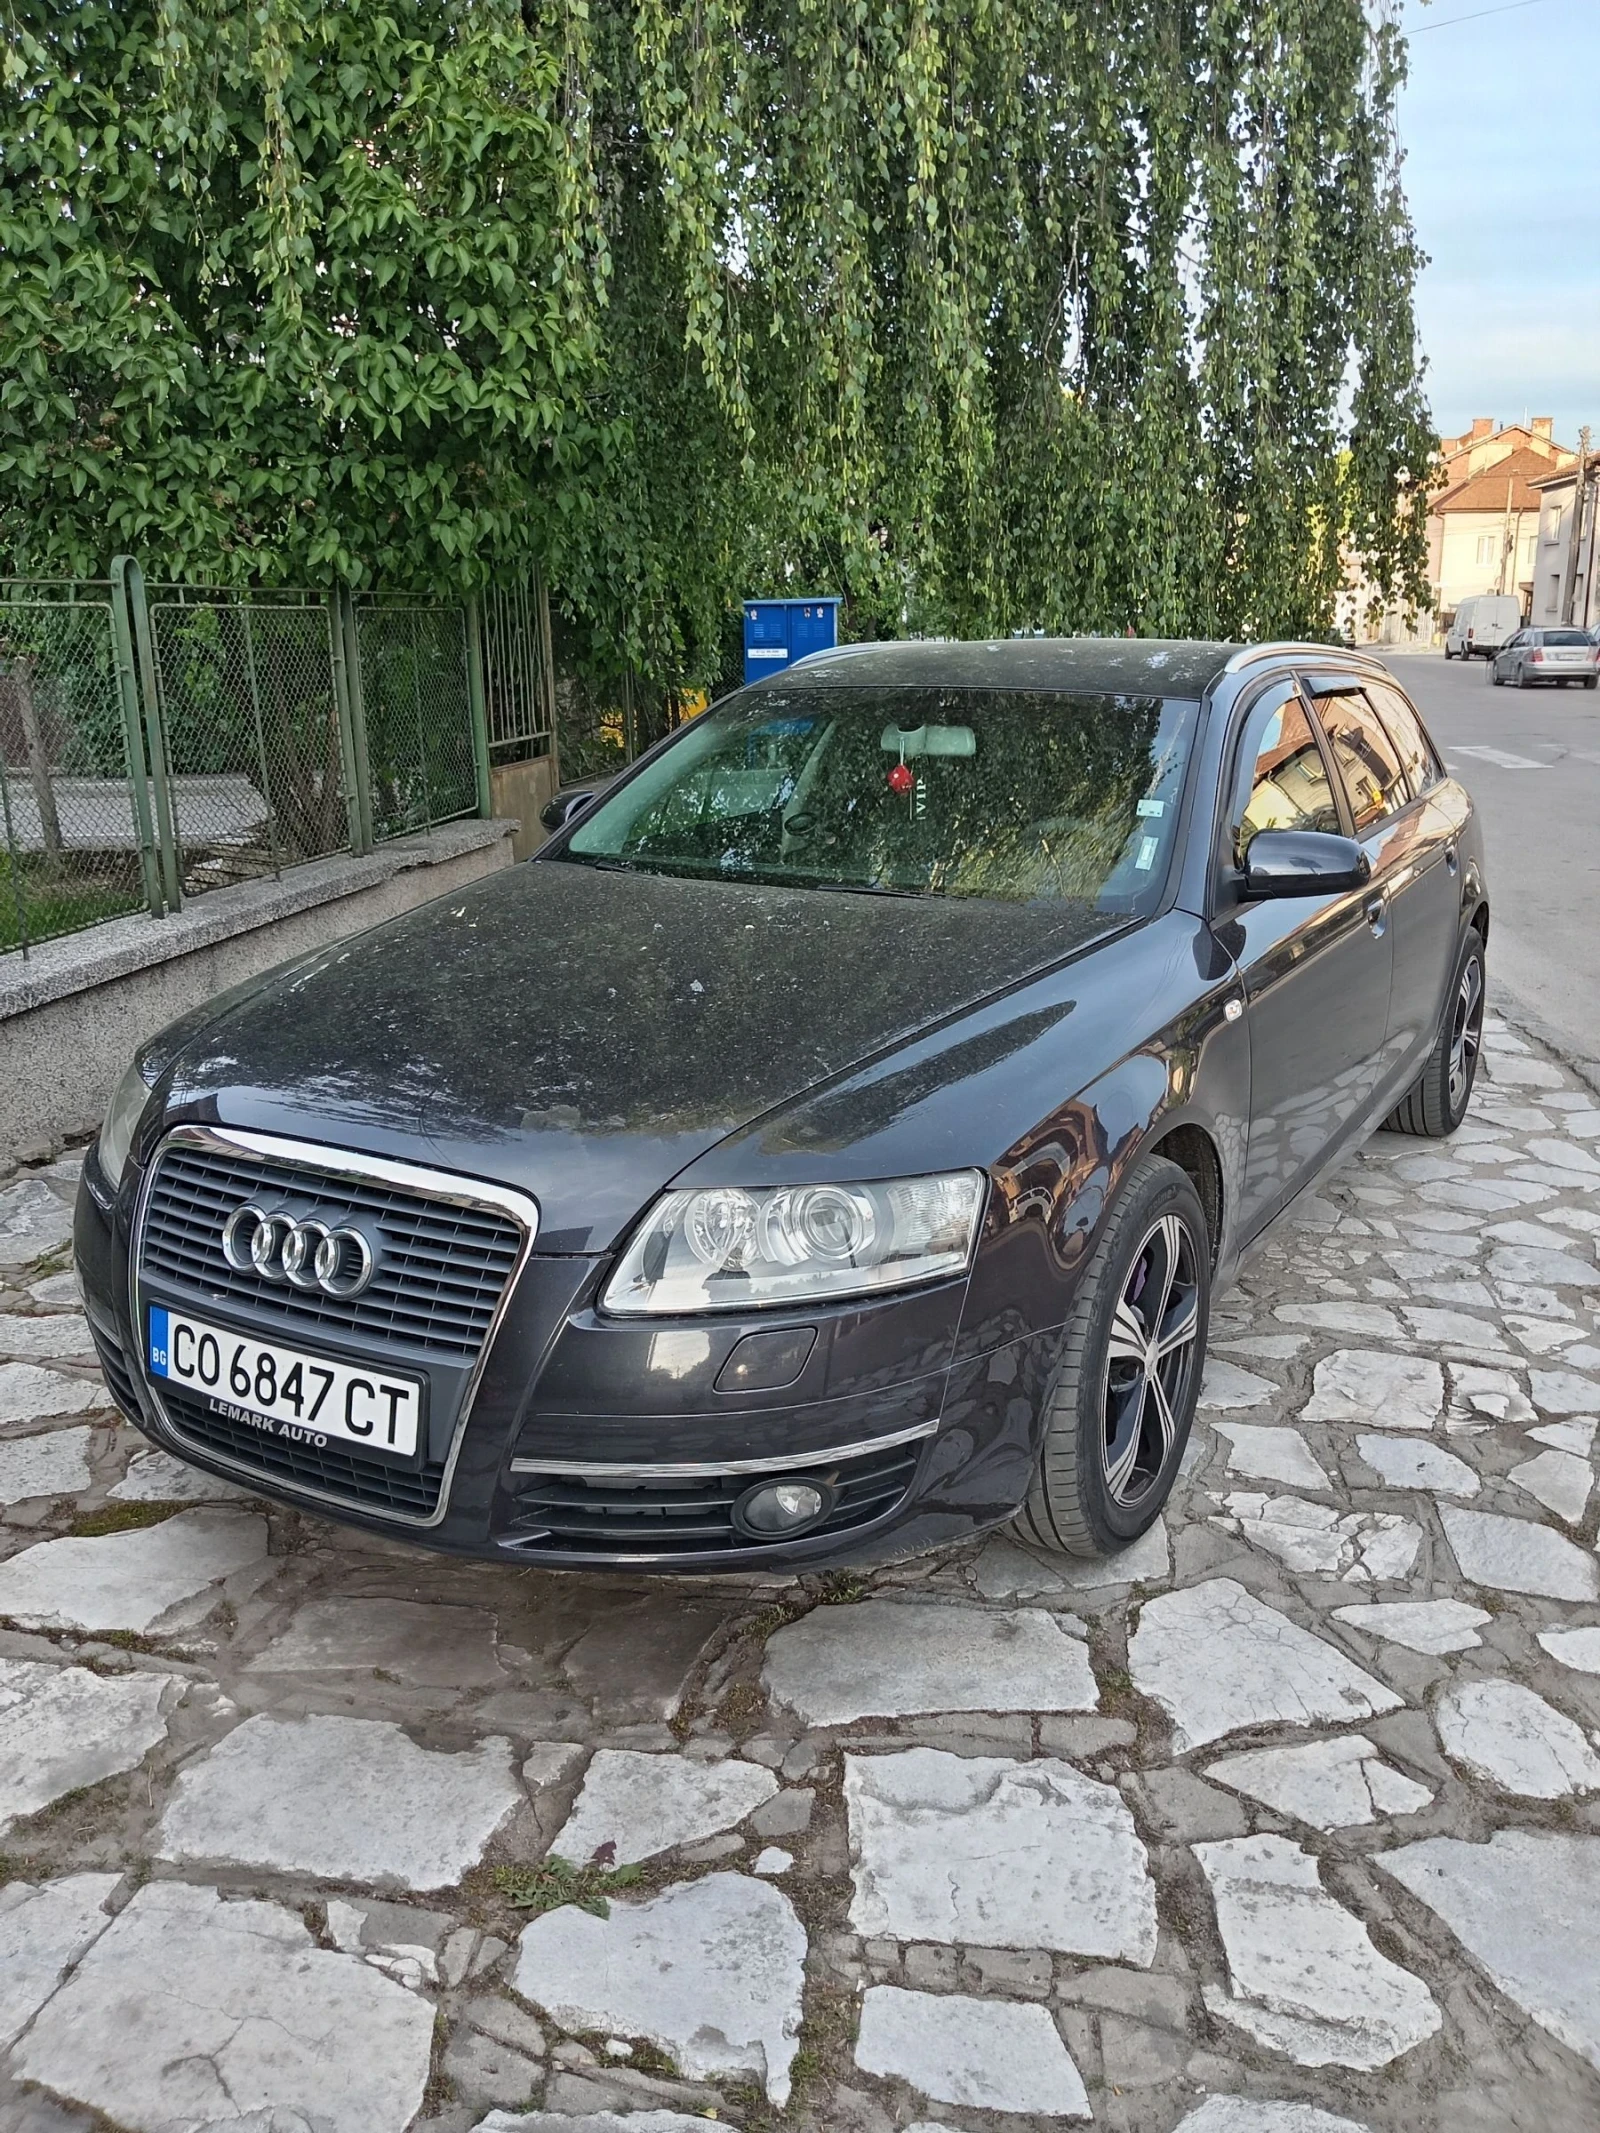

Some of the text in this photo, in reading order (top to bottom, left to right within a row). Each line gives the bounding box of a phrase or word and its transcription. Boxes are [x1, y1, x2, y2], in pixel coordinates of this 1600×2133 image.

[152, 1346, 167, 1366] BG
[230, 1344, 335, 1422] 6847
[345, 1378, 409, 1446] CT
[209, 1398, 328, 1448] LEMARK AUTO
